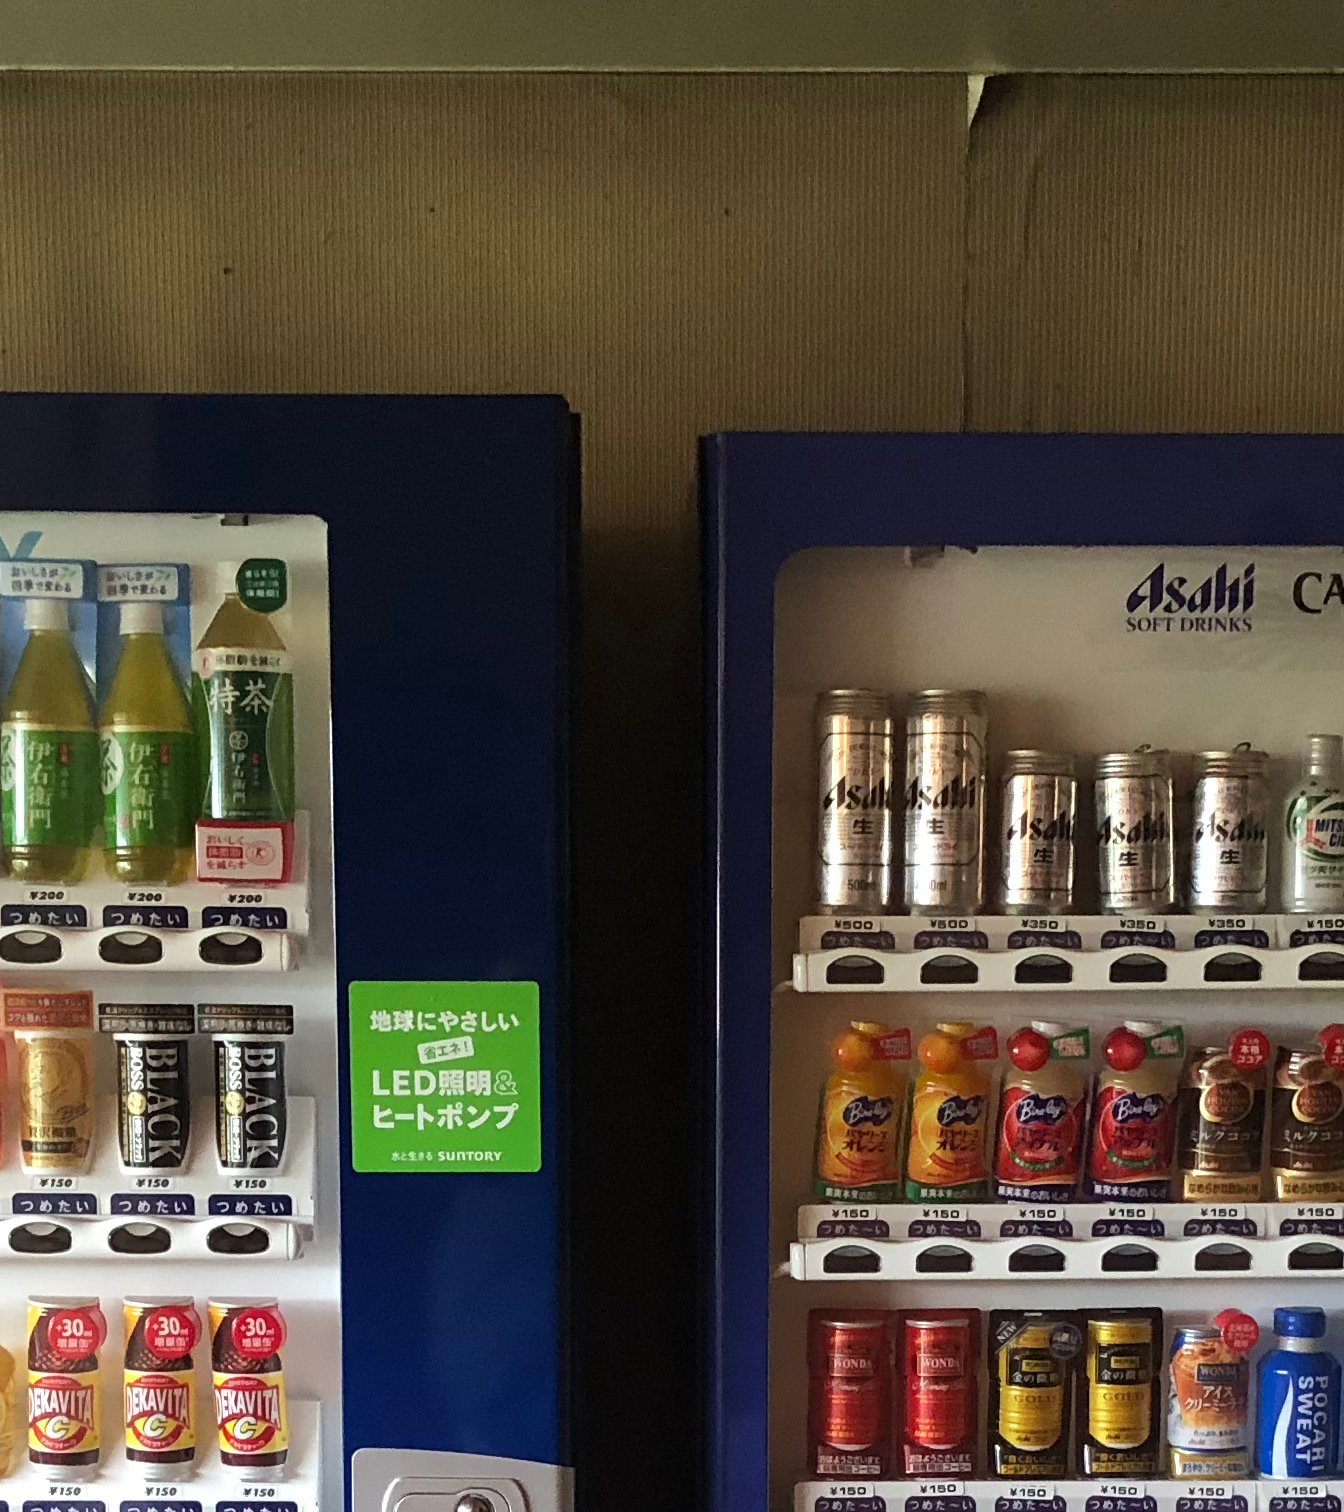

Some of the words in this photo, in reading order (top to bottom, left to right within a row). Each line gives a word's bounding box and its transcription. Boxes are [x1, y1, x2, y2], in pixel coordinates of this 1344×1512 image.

[11, 566, 59, 579] おいしさが
[11, 580, 72, 594] 四季で変わる
[106, 583, 168, 596] 四季で変わる
[1125, 562, 1256, 615] Asahi
[1126, 617, 1174, 633] SOFT
[1179, 616, 1253, 633] DRINKS
[210, 679, 273, 716] 特茶
[29, 741, 54, 829] 伊右衛門
[130, 741, 155, 829] 伊右衛門
[852, 818, 874, 836] 生
[927, 818, 945, 836] 生
[1033, 847, 1055, 864] 生
[1117, 850, 1140, 867] 生
[1219, 849, 1242, 867] 生
[127, 892, 163, 902] ¥200
[10, 912, 79, 924] つめたい
[210, 913, 280, 927] つめたい
[834, 919, 874, 930] ¥500
[1021, 919, 1059, 930] ¥350
[1208, 918, 1246, 928] ¥350
[369, 1009, 521, 1033] 地球にやさしい
[424, 1040, 470, 1061] 省エネ!
[1236, 1054, 1262, 1065] ココア
[129, 1046, 145, 1091] BOSS
[228, 1046, 243, 1091] BOSS
[372, 1069, 519, 1097] LED照明&
[146, 1047, 182, 1160] BLACK
[244, 1047, 280, 1160] BLACK
[373, 1101, 520, 1131] ヒートポンプ
[391, 1152, 434, 1162] 水と生きる
[437, 1151, 503, 1162] SUNTORY
[136, 1178, 170, 1188] ¥150
[20, 1199, 90, 1213] つめたい
[216, 1200, 286, 1214] つめたい
[832, 1209, 869, 1219] ¥150
[1019, 1209, 1057, 1219] ¥150
[1201, 1208, 1238, 1217] ¥150
[996, 1323, 1017, 1343] NEW
[1203, 1385, 1234, 1399] アイス
[29, 1386, 94, 1425] DEKAVITA
[126, 1386, 190, 1426] DEKAVITA
[216, 1387, 280, 1428] DEKAVITA
[45, 1414, 70, 1440] C
[143, 1413, 167, 1439] C
[233, 1415, 258, 1441] C
[1295, 1375, 1314, 1464] SWEAT
[1312, 1375, 1330, 1472] POCARI
[145, 1487, 178, 1497] ¥150
[830, 1486, 867, 1496] ¥150
[1010, 1488, 1046, 1498] ¥150
[1189, 1487, 1225, 1497] ¥150
